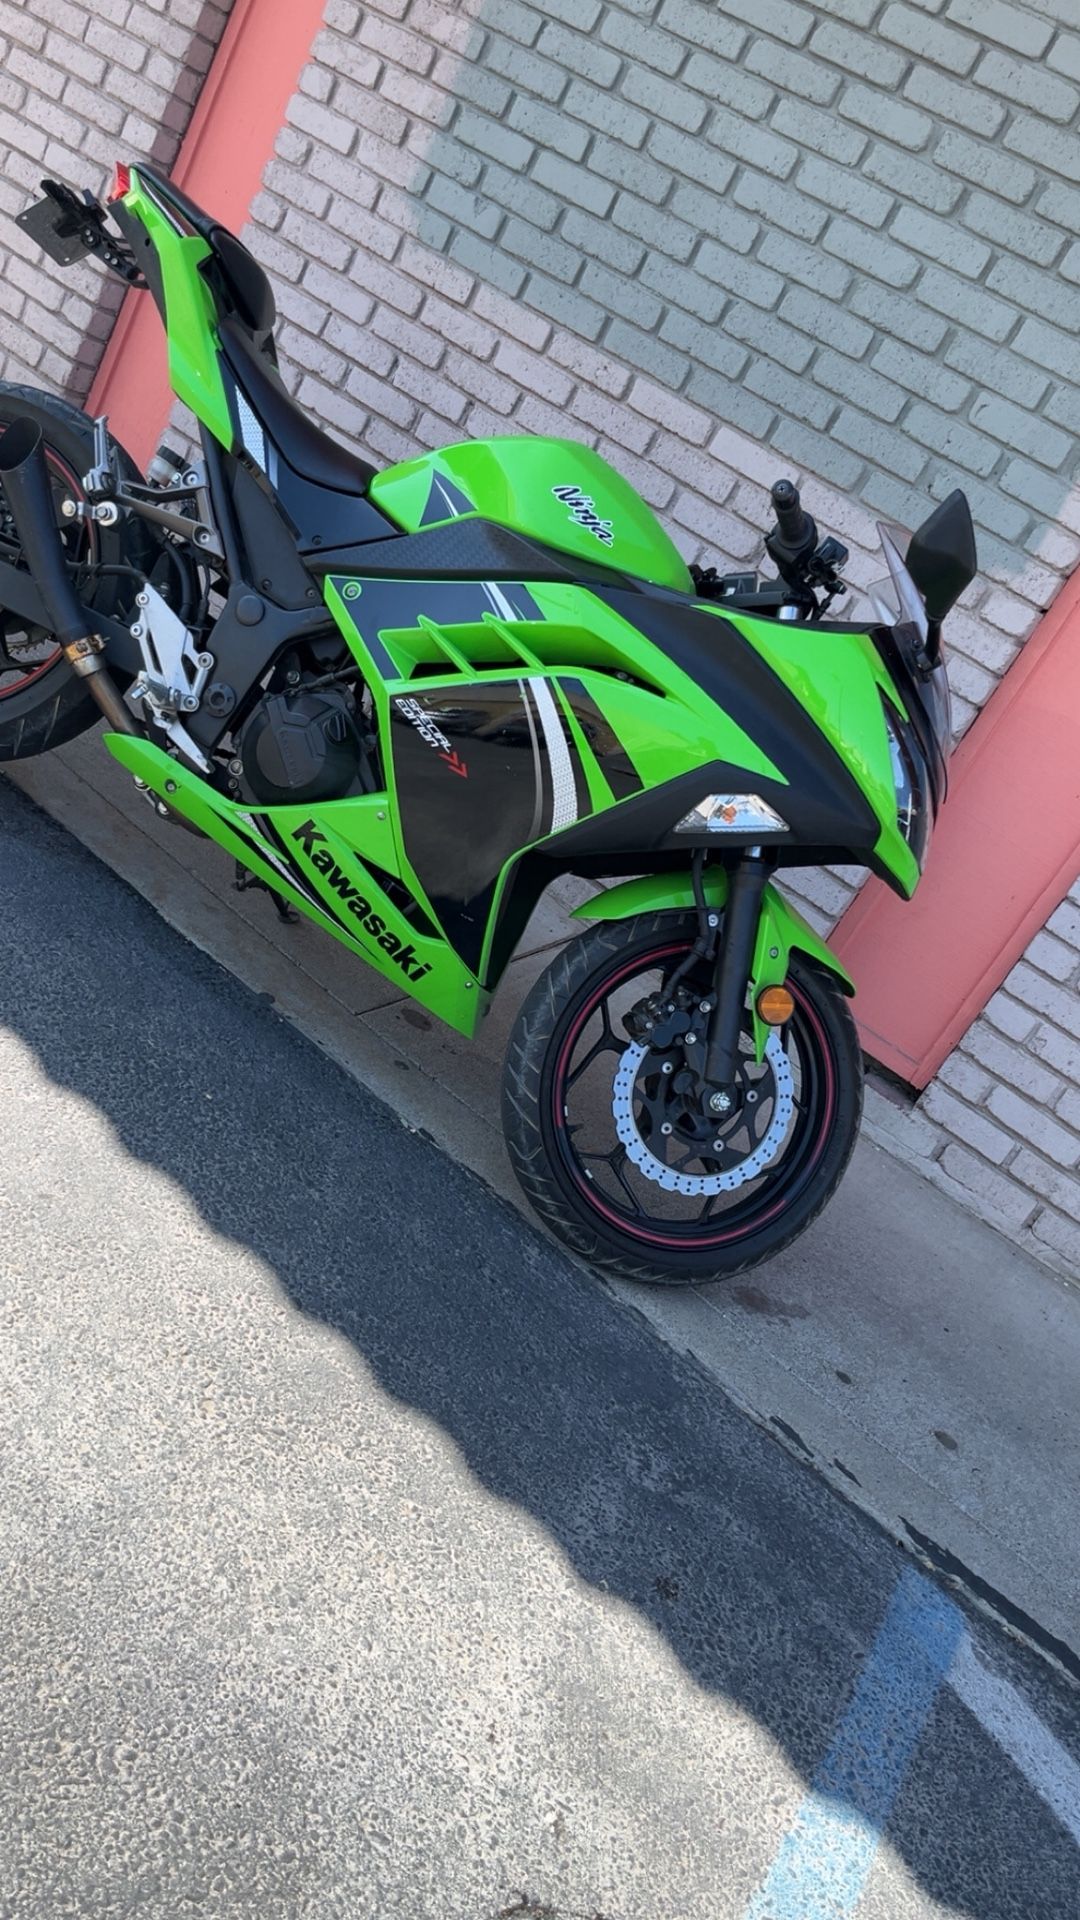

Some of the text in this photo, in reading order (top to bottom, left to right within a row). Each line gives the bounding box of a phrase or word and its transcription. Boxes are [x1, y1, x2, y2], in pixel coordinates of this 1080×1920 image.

[551, 485, 614, 548] Ninja
[395, 698, 439, 747] EDITION
[405, 698, 452, 753] SPECIAL
[291, 819, 433, 982] Kawasaki
